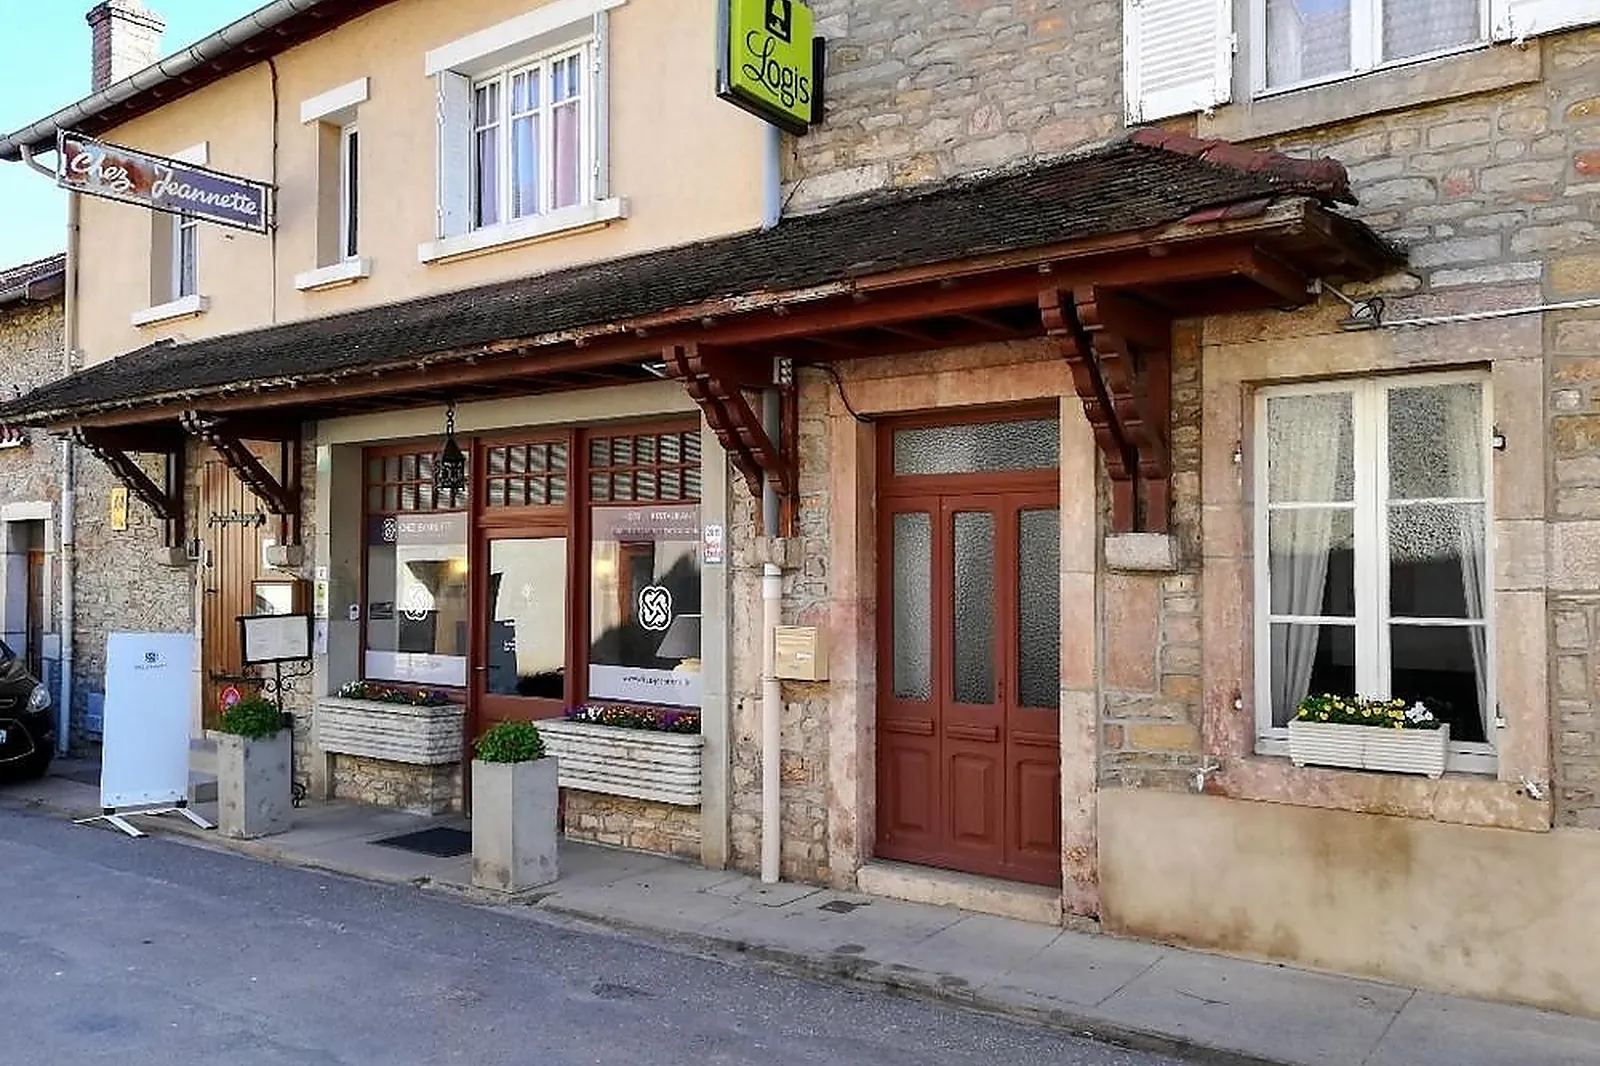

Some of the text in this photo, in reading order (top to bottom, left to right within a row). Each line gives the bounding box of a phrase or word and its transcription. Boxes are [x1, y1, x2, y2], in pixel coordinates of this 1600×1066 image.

[742, 30, 810, 108] Logis
[71, 150, 258, 216] Chez Jeannette
